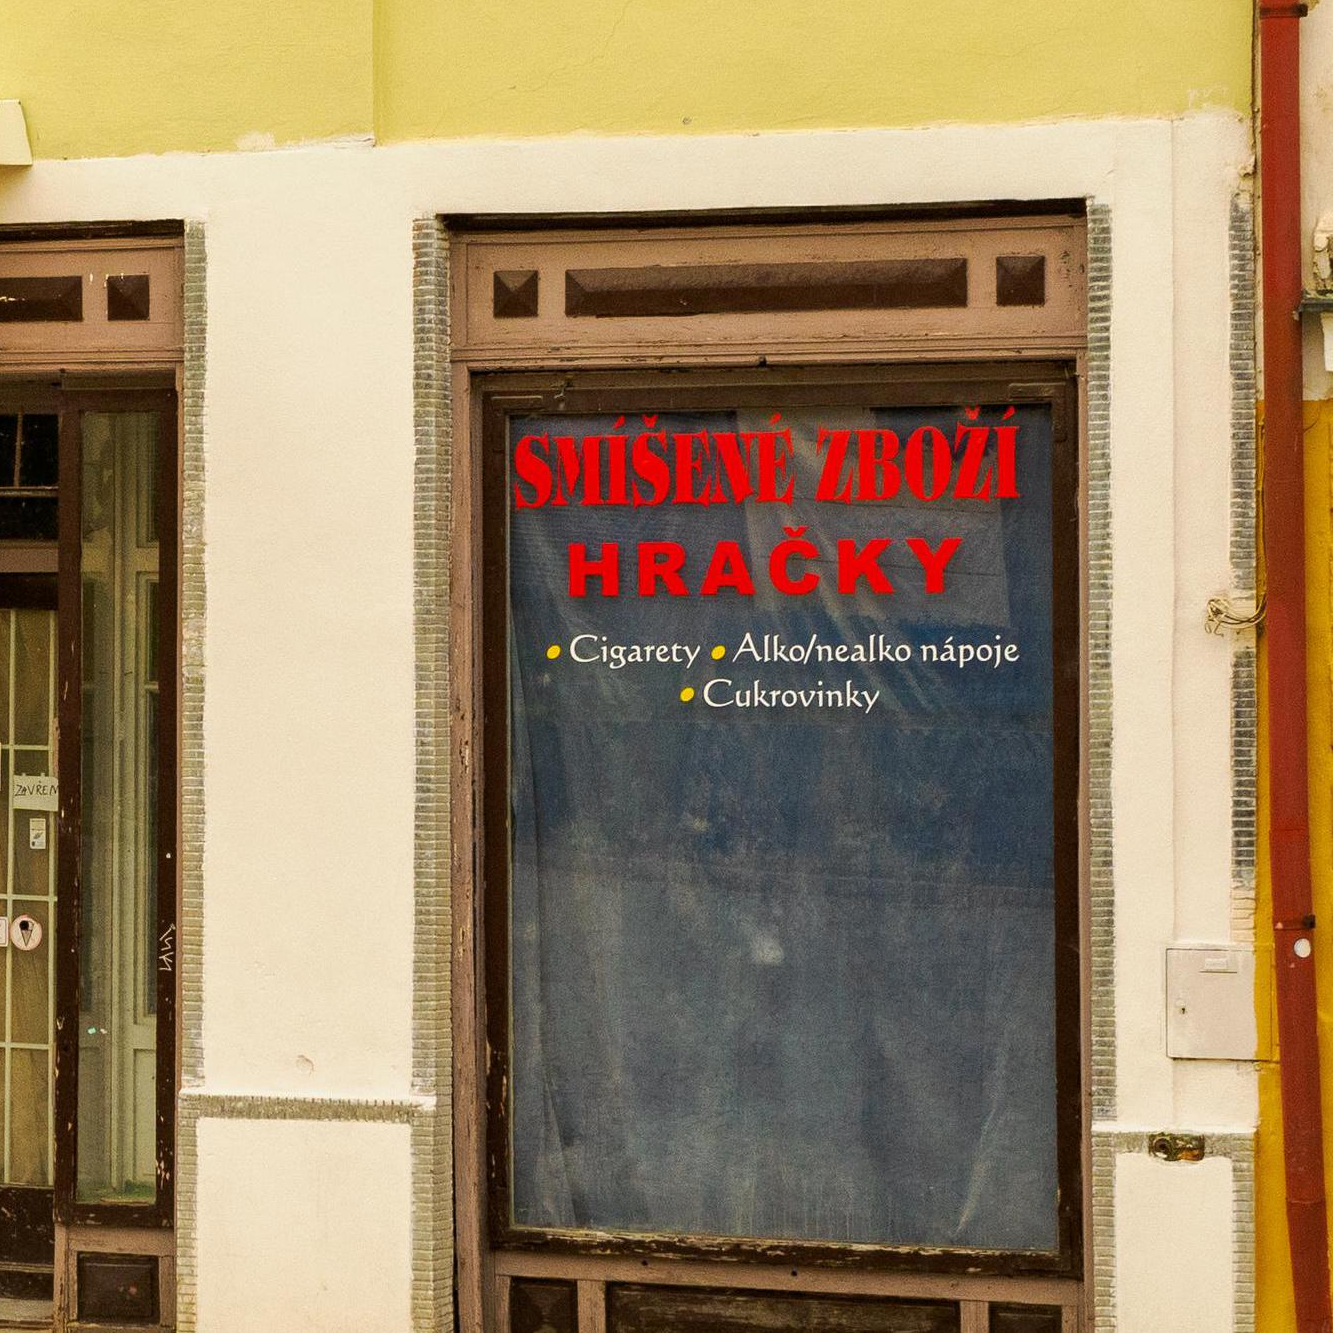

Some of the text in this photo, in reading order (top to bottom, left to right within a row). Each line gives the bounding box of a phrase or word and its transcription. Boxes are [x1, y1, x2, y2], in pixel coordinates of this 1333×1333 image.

[514, 405, 1020, 510] SMÍŠENÉ ZBOŽÍ
[568, 526, 962, 597] HRAČKY
[569, 632, 1020, 669] Cigarety Alko/nealko nápoje
[703, 679, 880, 713] Cukrovinky
